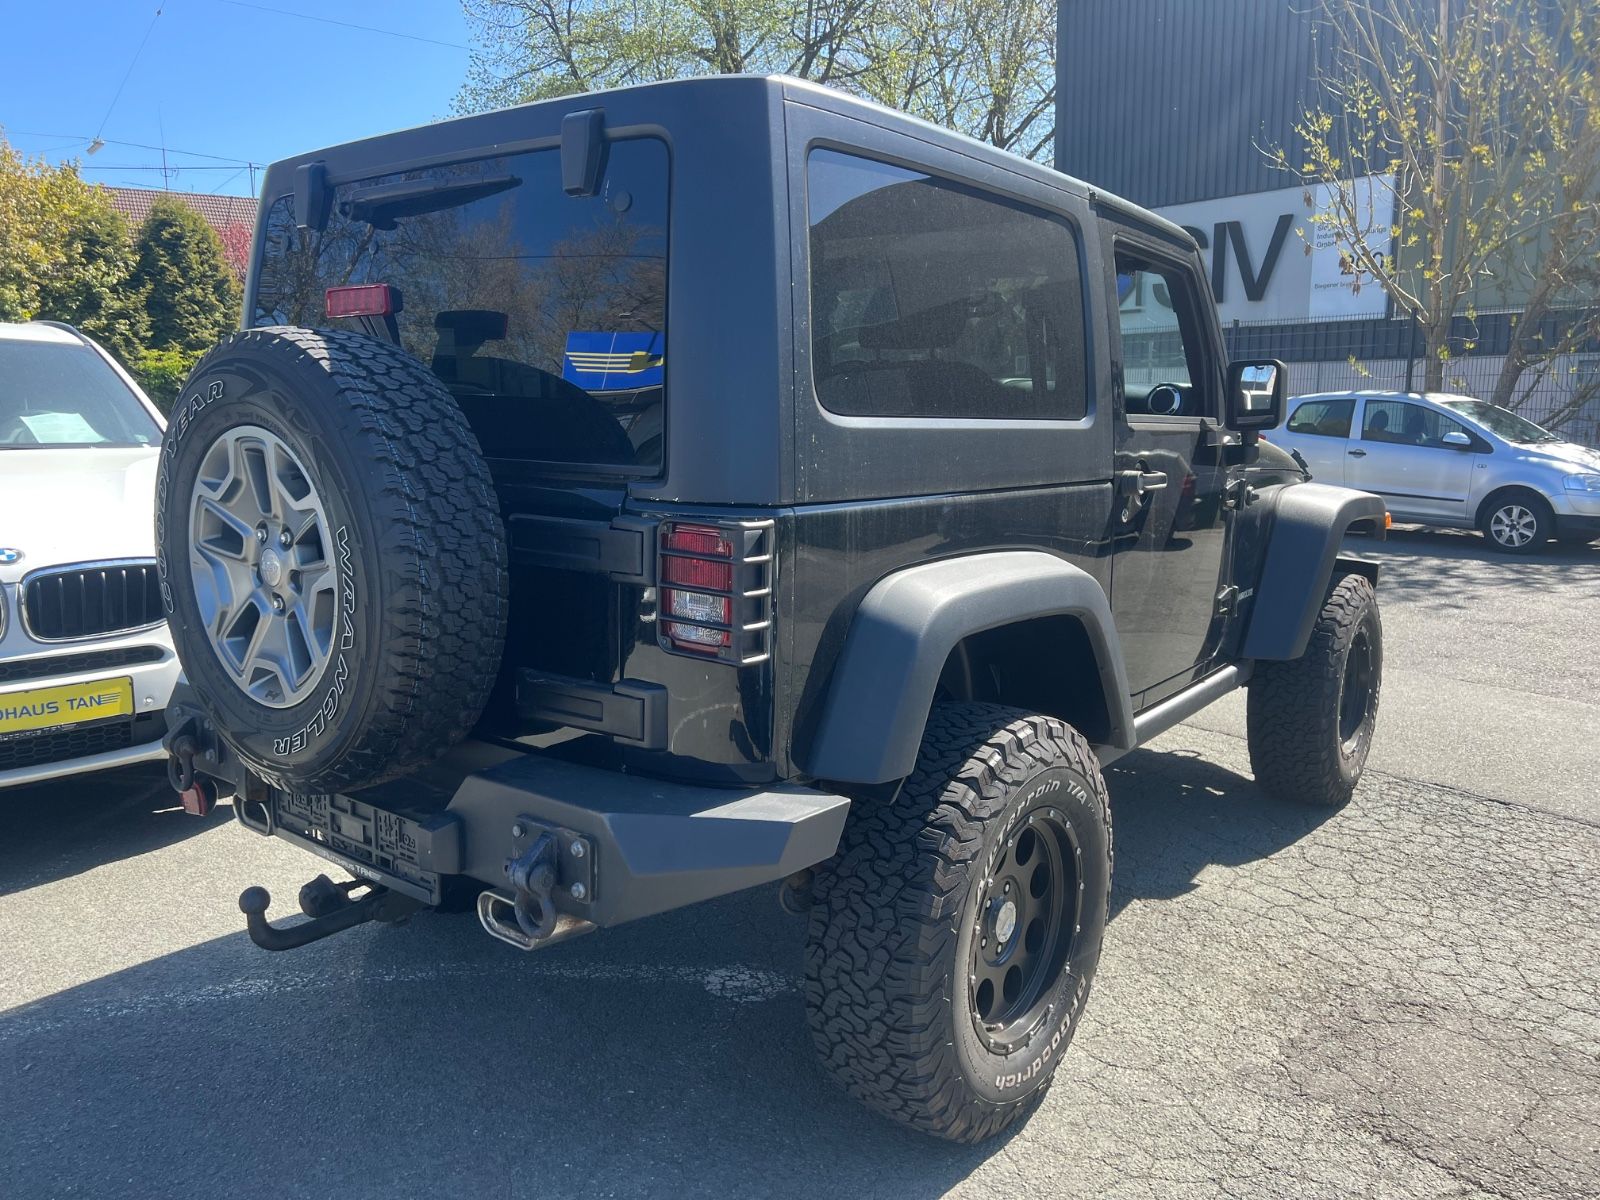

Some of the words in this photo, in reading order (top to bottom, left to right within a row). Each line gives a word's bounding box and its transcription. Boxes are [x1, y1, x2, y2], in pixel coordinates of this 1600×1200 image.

[273, 525, 354, 756] WRANGLER
[0, 700, 59, 721] HAUS
[66, 694, 102, 711] TAN
[1066, 780, 1088, 806] T/A
[995, 973, 1087, 1091] BFGoodrich
